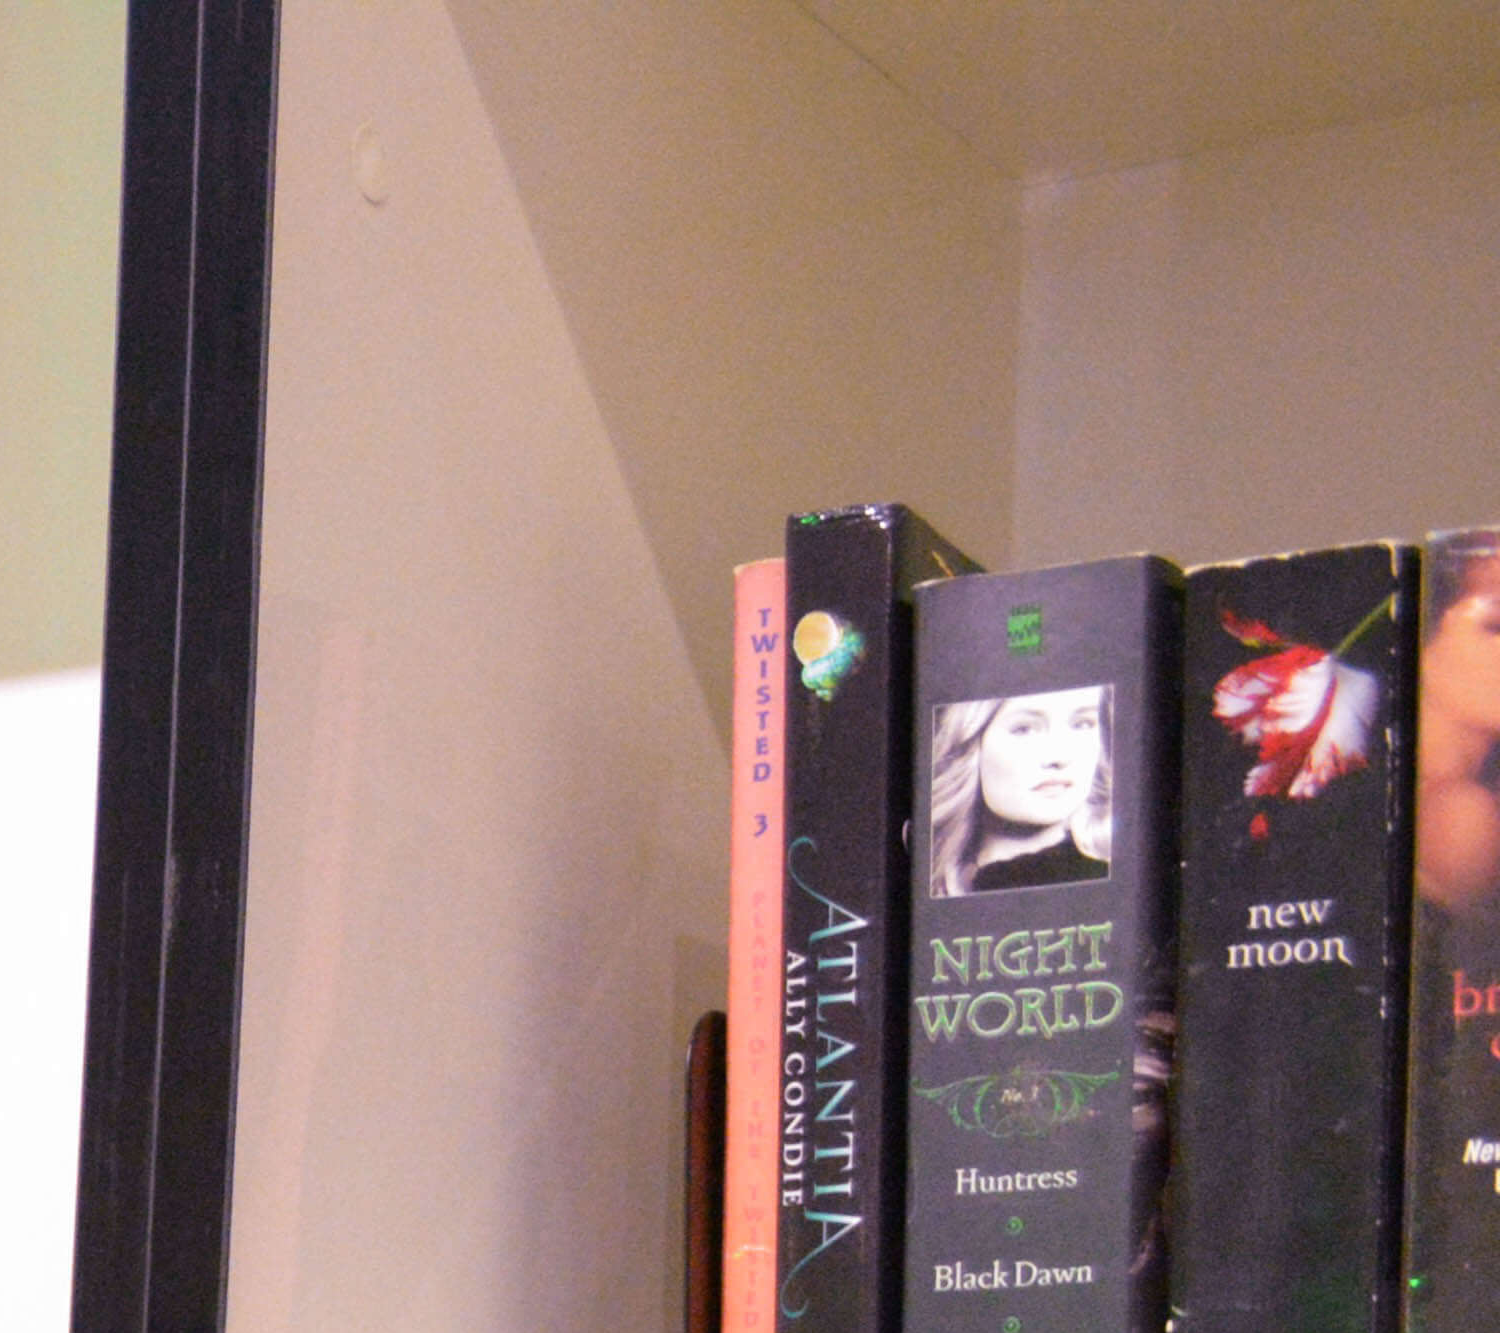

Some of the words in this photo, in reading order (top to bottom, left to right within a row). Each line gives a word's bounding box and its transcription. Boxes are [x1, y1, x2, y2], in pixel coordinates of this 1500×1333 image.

[751, 607, 778, 783] TWISTED
[754, 814, 768, 838] 3
[1247, 897, 1332, 930] new
[930, 923, 1113, 985] NIGHT
[1226, 935, 1355, 970] moon
[786, 948, 807, 1041] ALLY
[916, 980, 1124, 1041] WORLD
[780, 836, 870, 1319] ATLANTIA
[781, 1051, 806, 1208] CONDIE
[955, 1166, 1078, 1195] Huntress
[934, 1259, 1008, 1292] Black
[1014, 1261, 1093, 1287] Dawn
